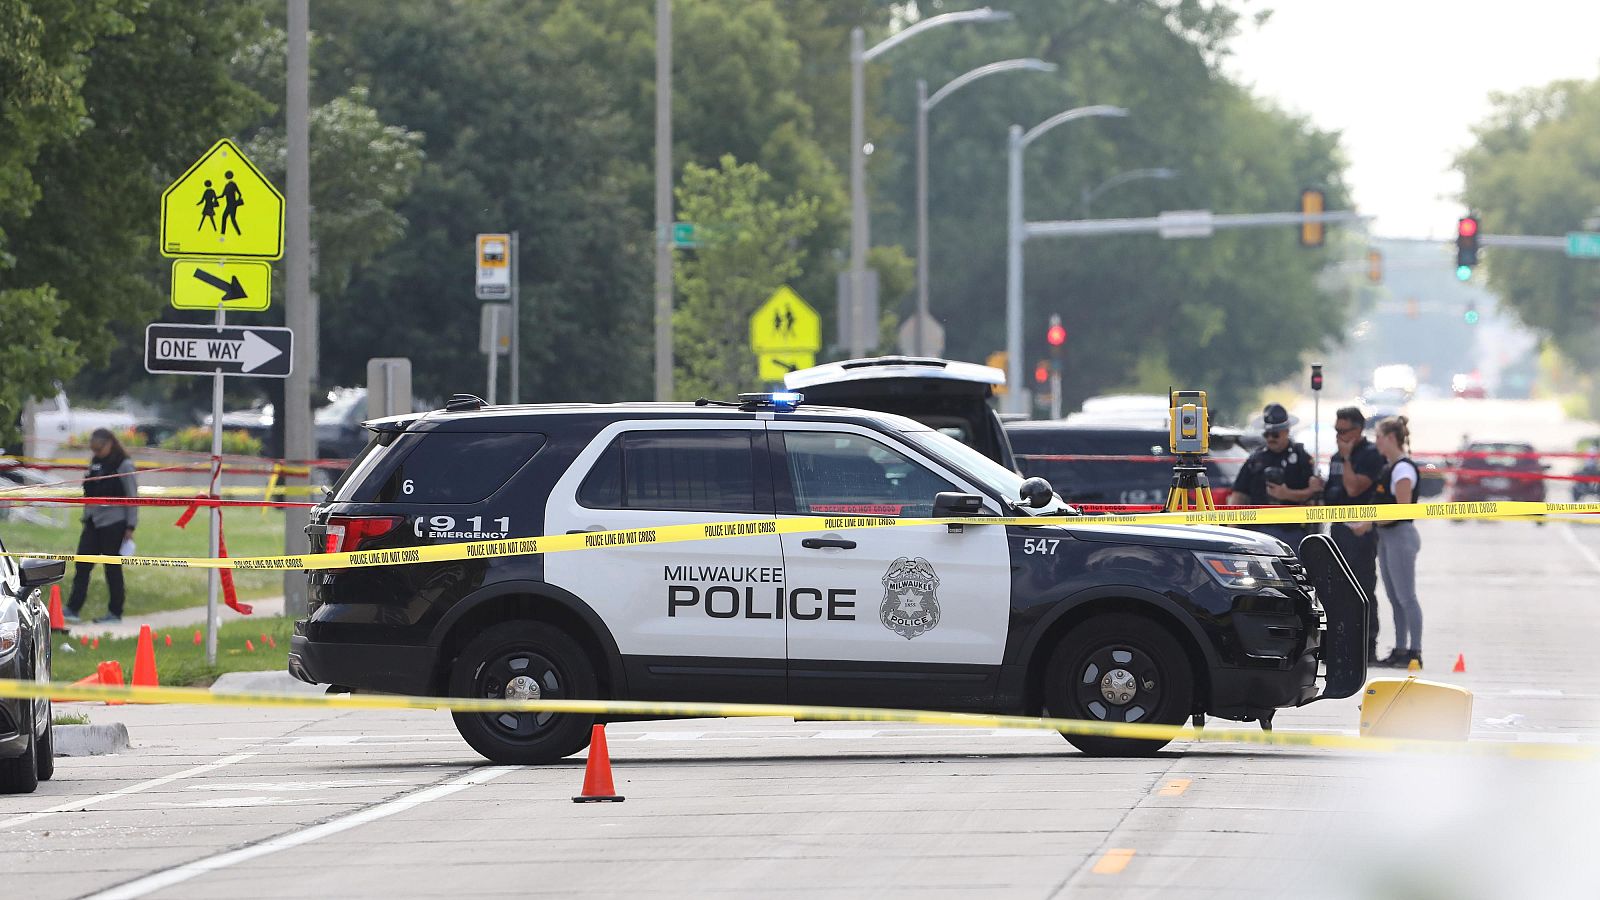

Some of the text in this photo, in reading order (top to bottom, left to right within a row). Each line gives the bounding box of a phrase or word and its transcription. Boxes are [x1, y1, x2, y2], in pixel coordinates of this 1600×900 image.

[160, 340, 242, 359] ONE WAY
[402, 480, 414, 494] 6
[430, 516, 510, 532] 911
[705, 522, 776, 537] POLICE LINE DO NOT CROSS
[825, 519, 843, 528] POLICE
[845, 519, 856, 528] LINE
[858, 519, 864, 527] DO
[866, 519, 877, 527] NOT
[585, 530, 656, 546] POLICE LINE DO NOT CROSS
[467, 541, 537, 557] POLICE LINE DO NOT CROSS
[1024, 539, 1060, 554] 547
[234, 558, 303, 569] POLICE LINE DO NOT CROSS
[350, 550, 419, 565] POLICE LINE DO NOT CROSS
[664, 566, 782, 582] MILWAUKEE
[890, 581, 932, 590] MILWAUKEE
[668, 586, 856, 620] POLICE
[891, 616, 928, 626] POLICE
